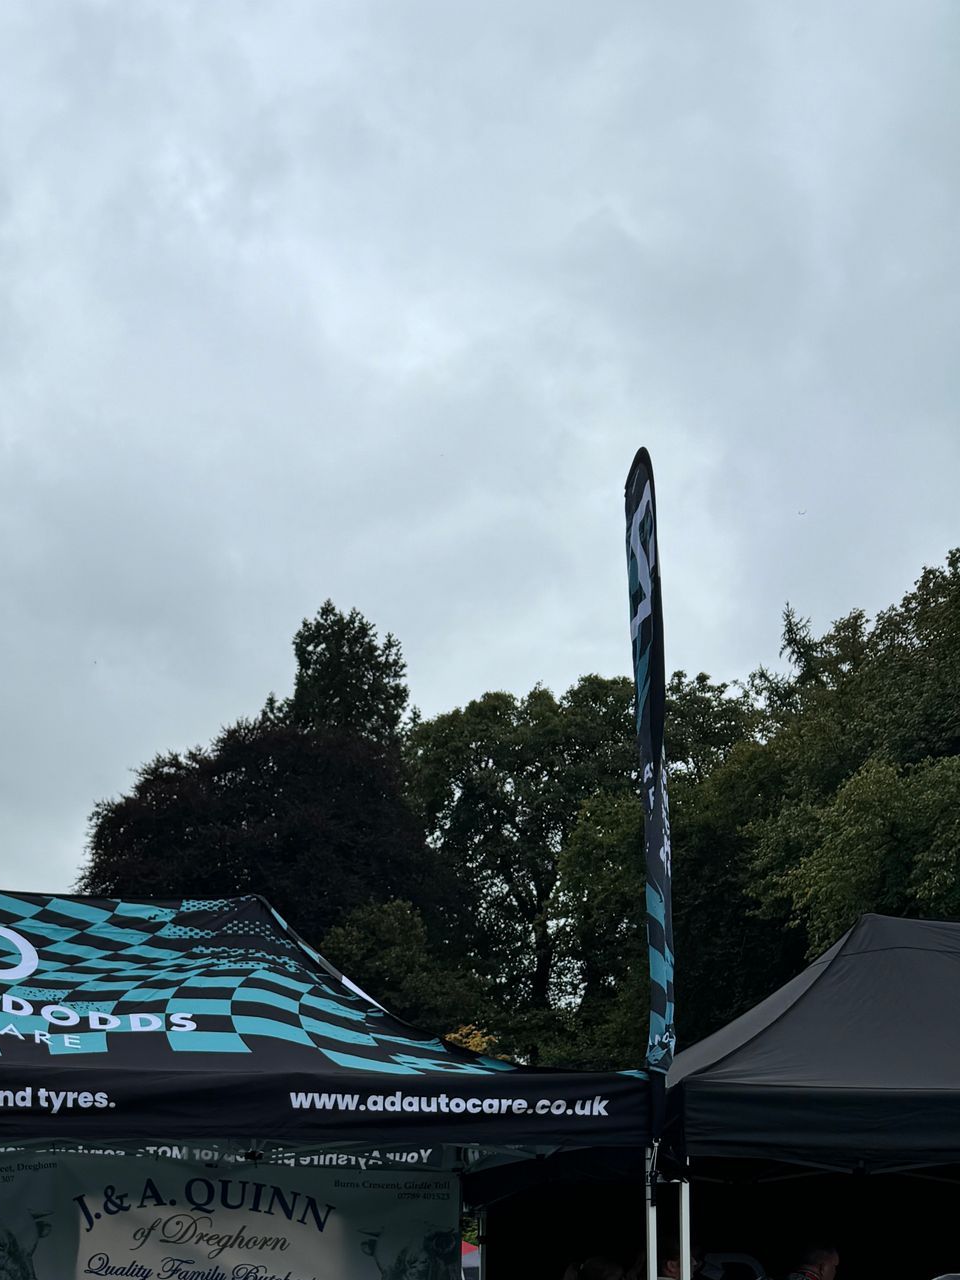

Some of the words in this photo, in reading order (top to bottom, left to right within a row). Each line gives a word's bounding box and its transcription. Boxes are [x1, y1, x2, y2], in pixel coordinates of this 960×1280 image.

[2, 993, 198, 1032] DODDS
[37, 1087, 116, 1113] tyres.
[290, 1091, 609, 1116] www.adautocare.co.uk
[16, 1162, 58, 1172] Dreghorn
[102, 1184, 132, 1215] &
[137, 1178, 178, 1209] A.
[185, 1178, 337, 1233] QUINN
[132, 1216, 160, 1252] of
[160, 1213, 291, 1261] Dreghorn
